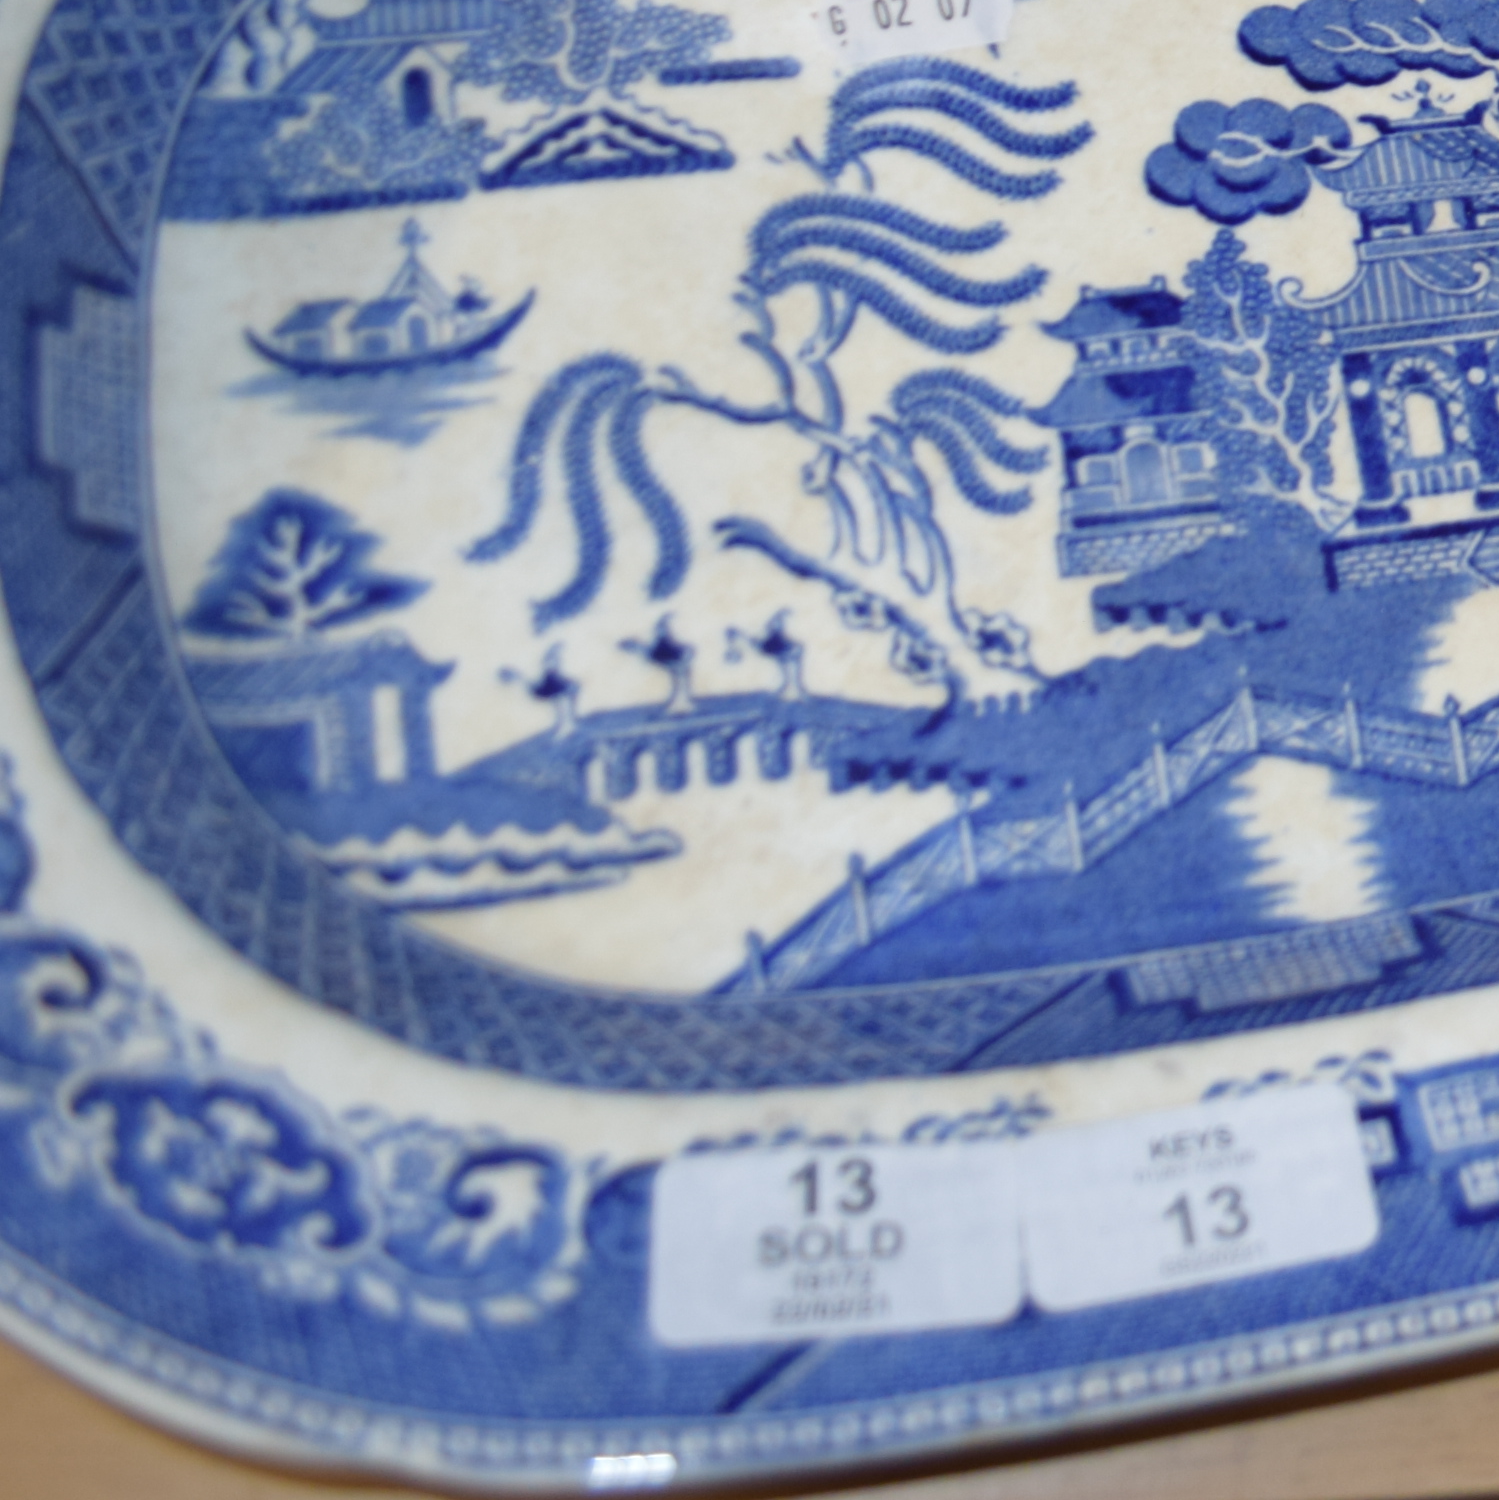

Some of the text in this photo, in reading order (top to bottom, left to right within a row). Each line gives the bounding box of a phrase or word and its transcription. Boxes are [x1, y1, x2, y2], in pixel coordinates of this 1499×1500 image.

[1149, 1123, 1234, 1160] KEYS
[788, 1157, 878, 1216] 13
[1163, 1184, 1251, 1248] 13
[756, 1220, 906, 1268] SOLD
